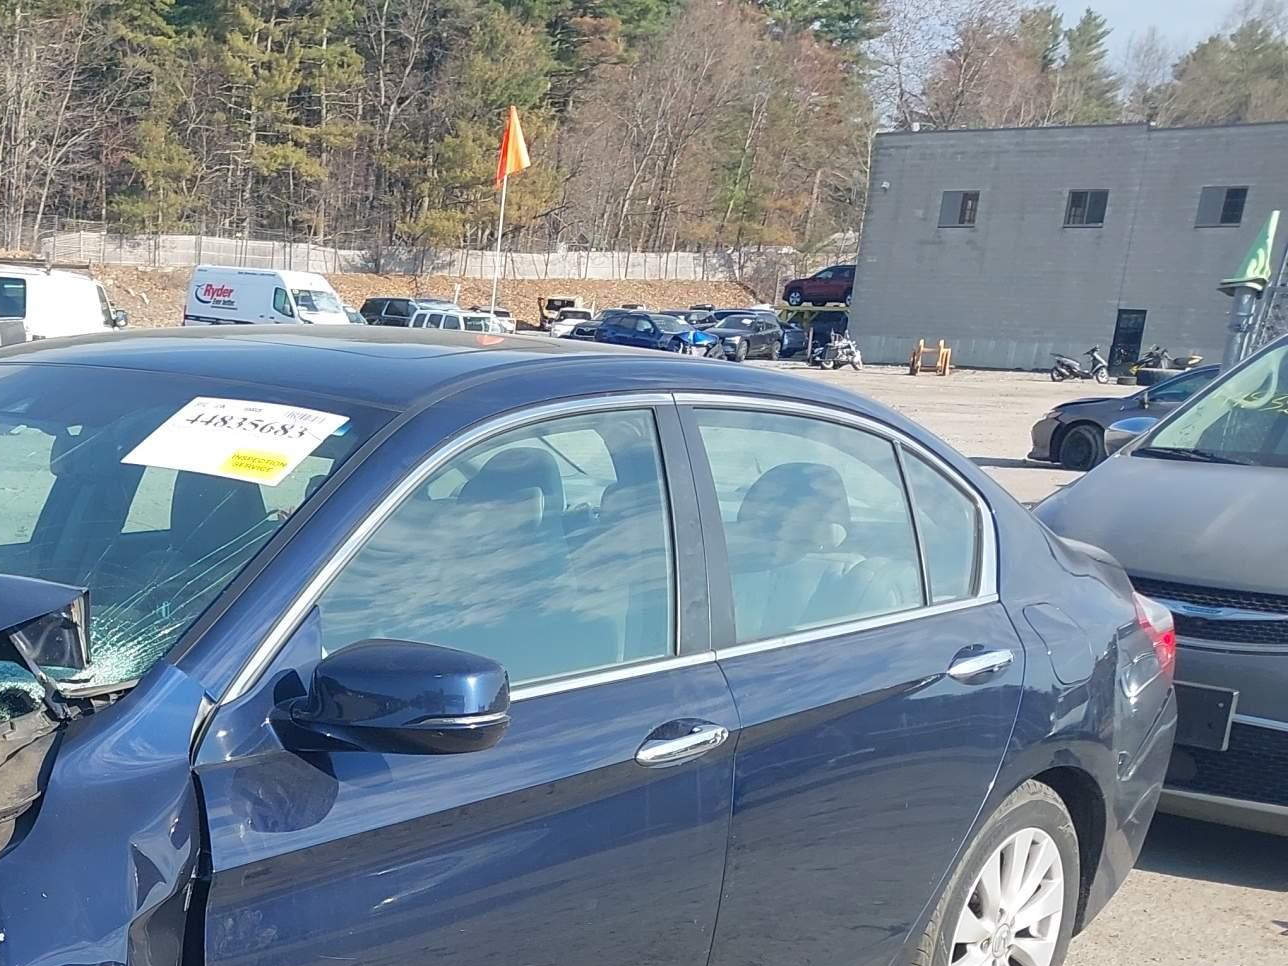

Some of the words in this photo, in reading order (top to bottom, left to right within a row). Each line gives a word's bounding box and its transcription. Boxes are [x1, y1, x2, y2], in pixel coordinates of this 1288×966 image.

[203, 283, 234, 300] Ryder
[185, 412, 309, 439] 44835683
[231, 454, 288, 467] INSPECTION
